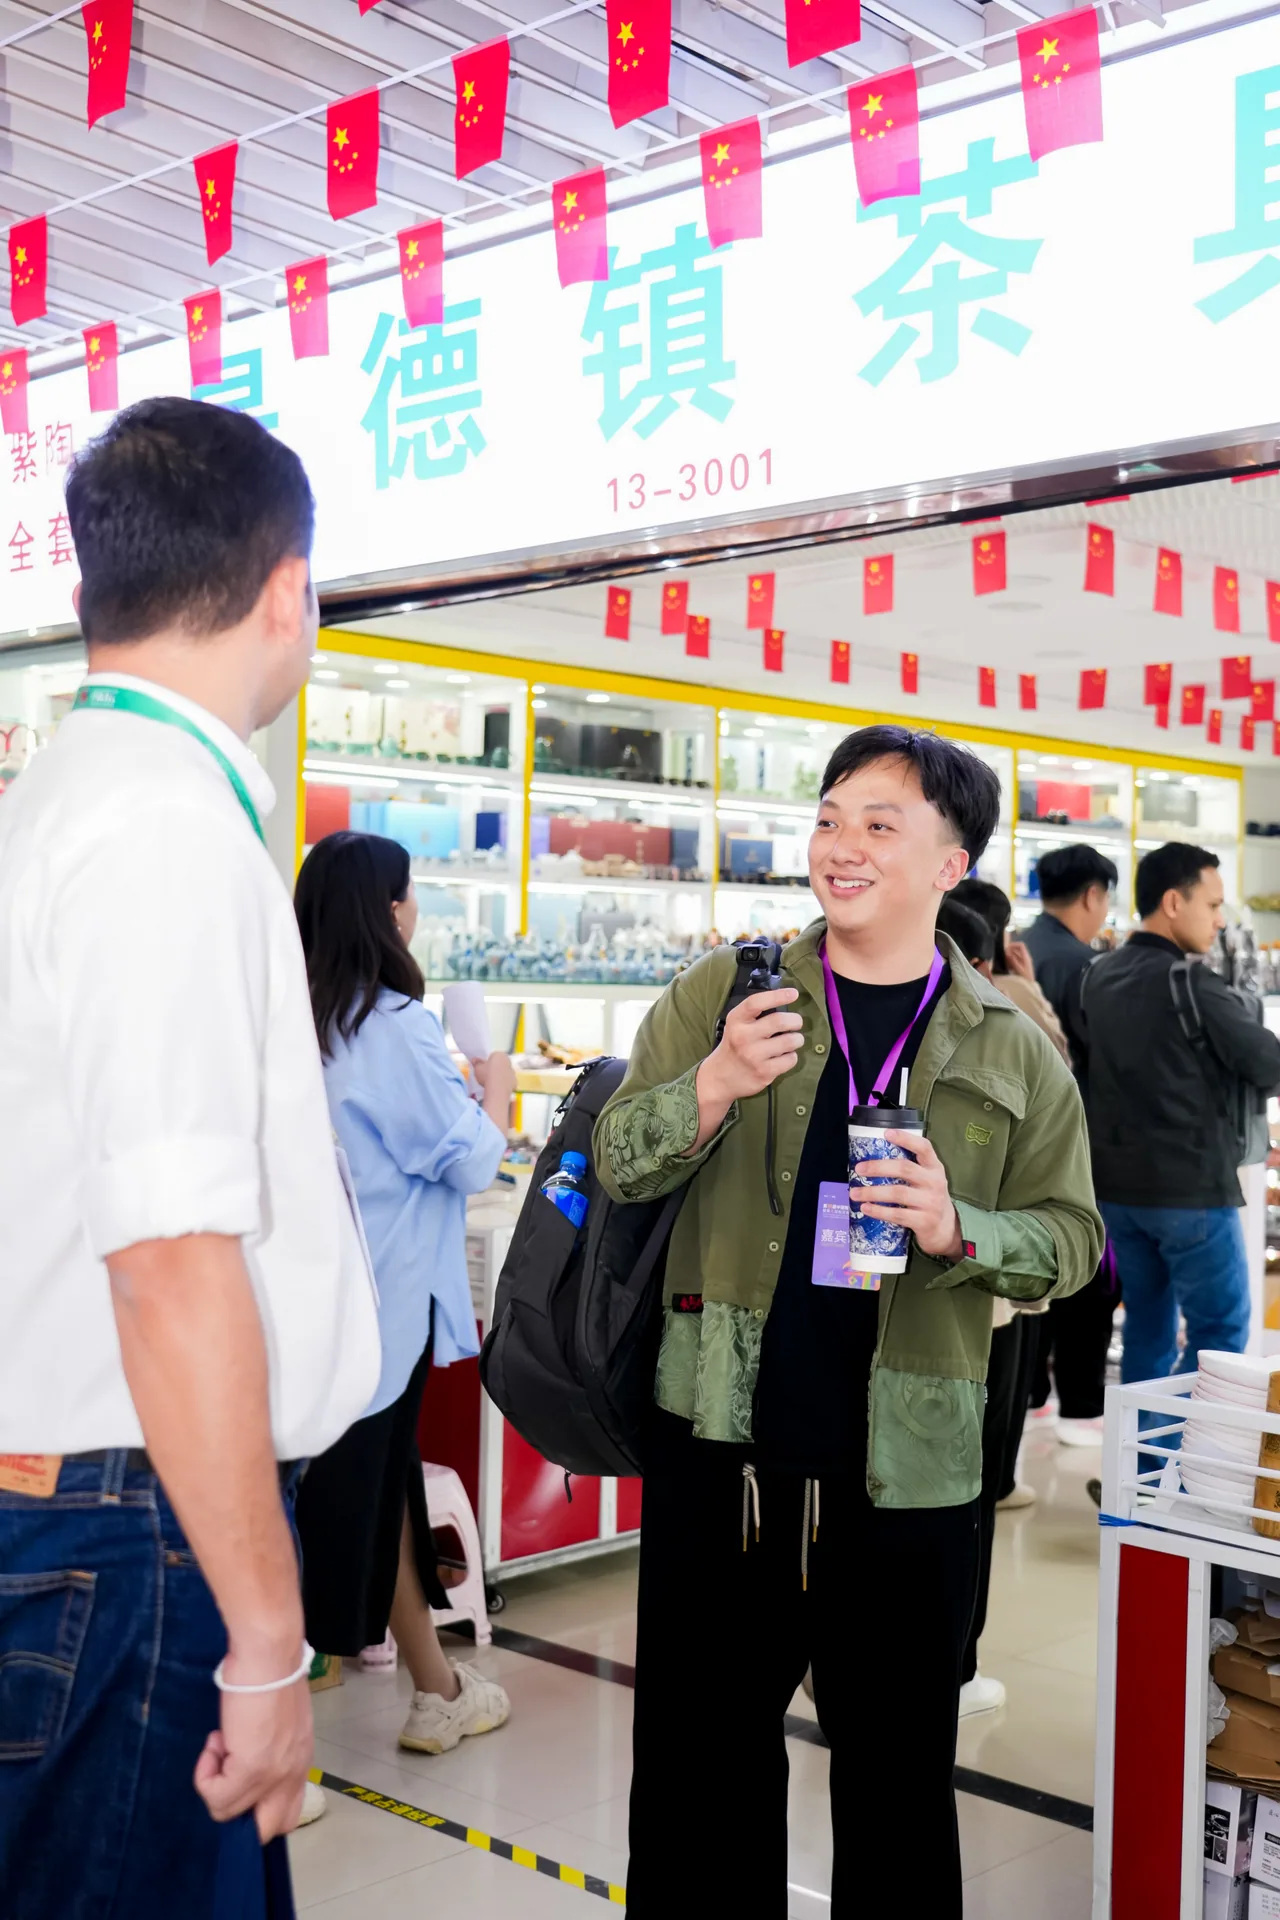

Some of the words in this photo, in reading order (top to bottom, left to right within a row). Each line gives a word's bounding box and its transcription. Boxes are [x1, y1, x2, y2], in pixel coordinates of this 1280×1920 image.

[607, 448, 772, 512] 13-3001
[8, 512, 74, 572] 全套
[821, 1229, 849, 1244] 嘉宾
